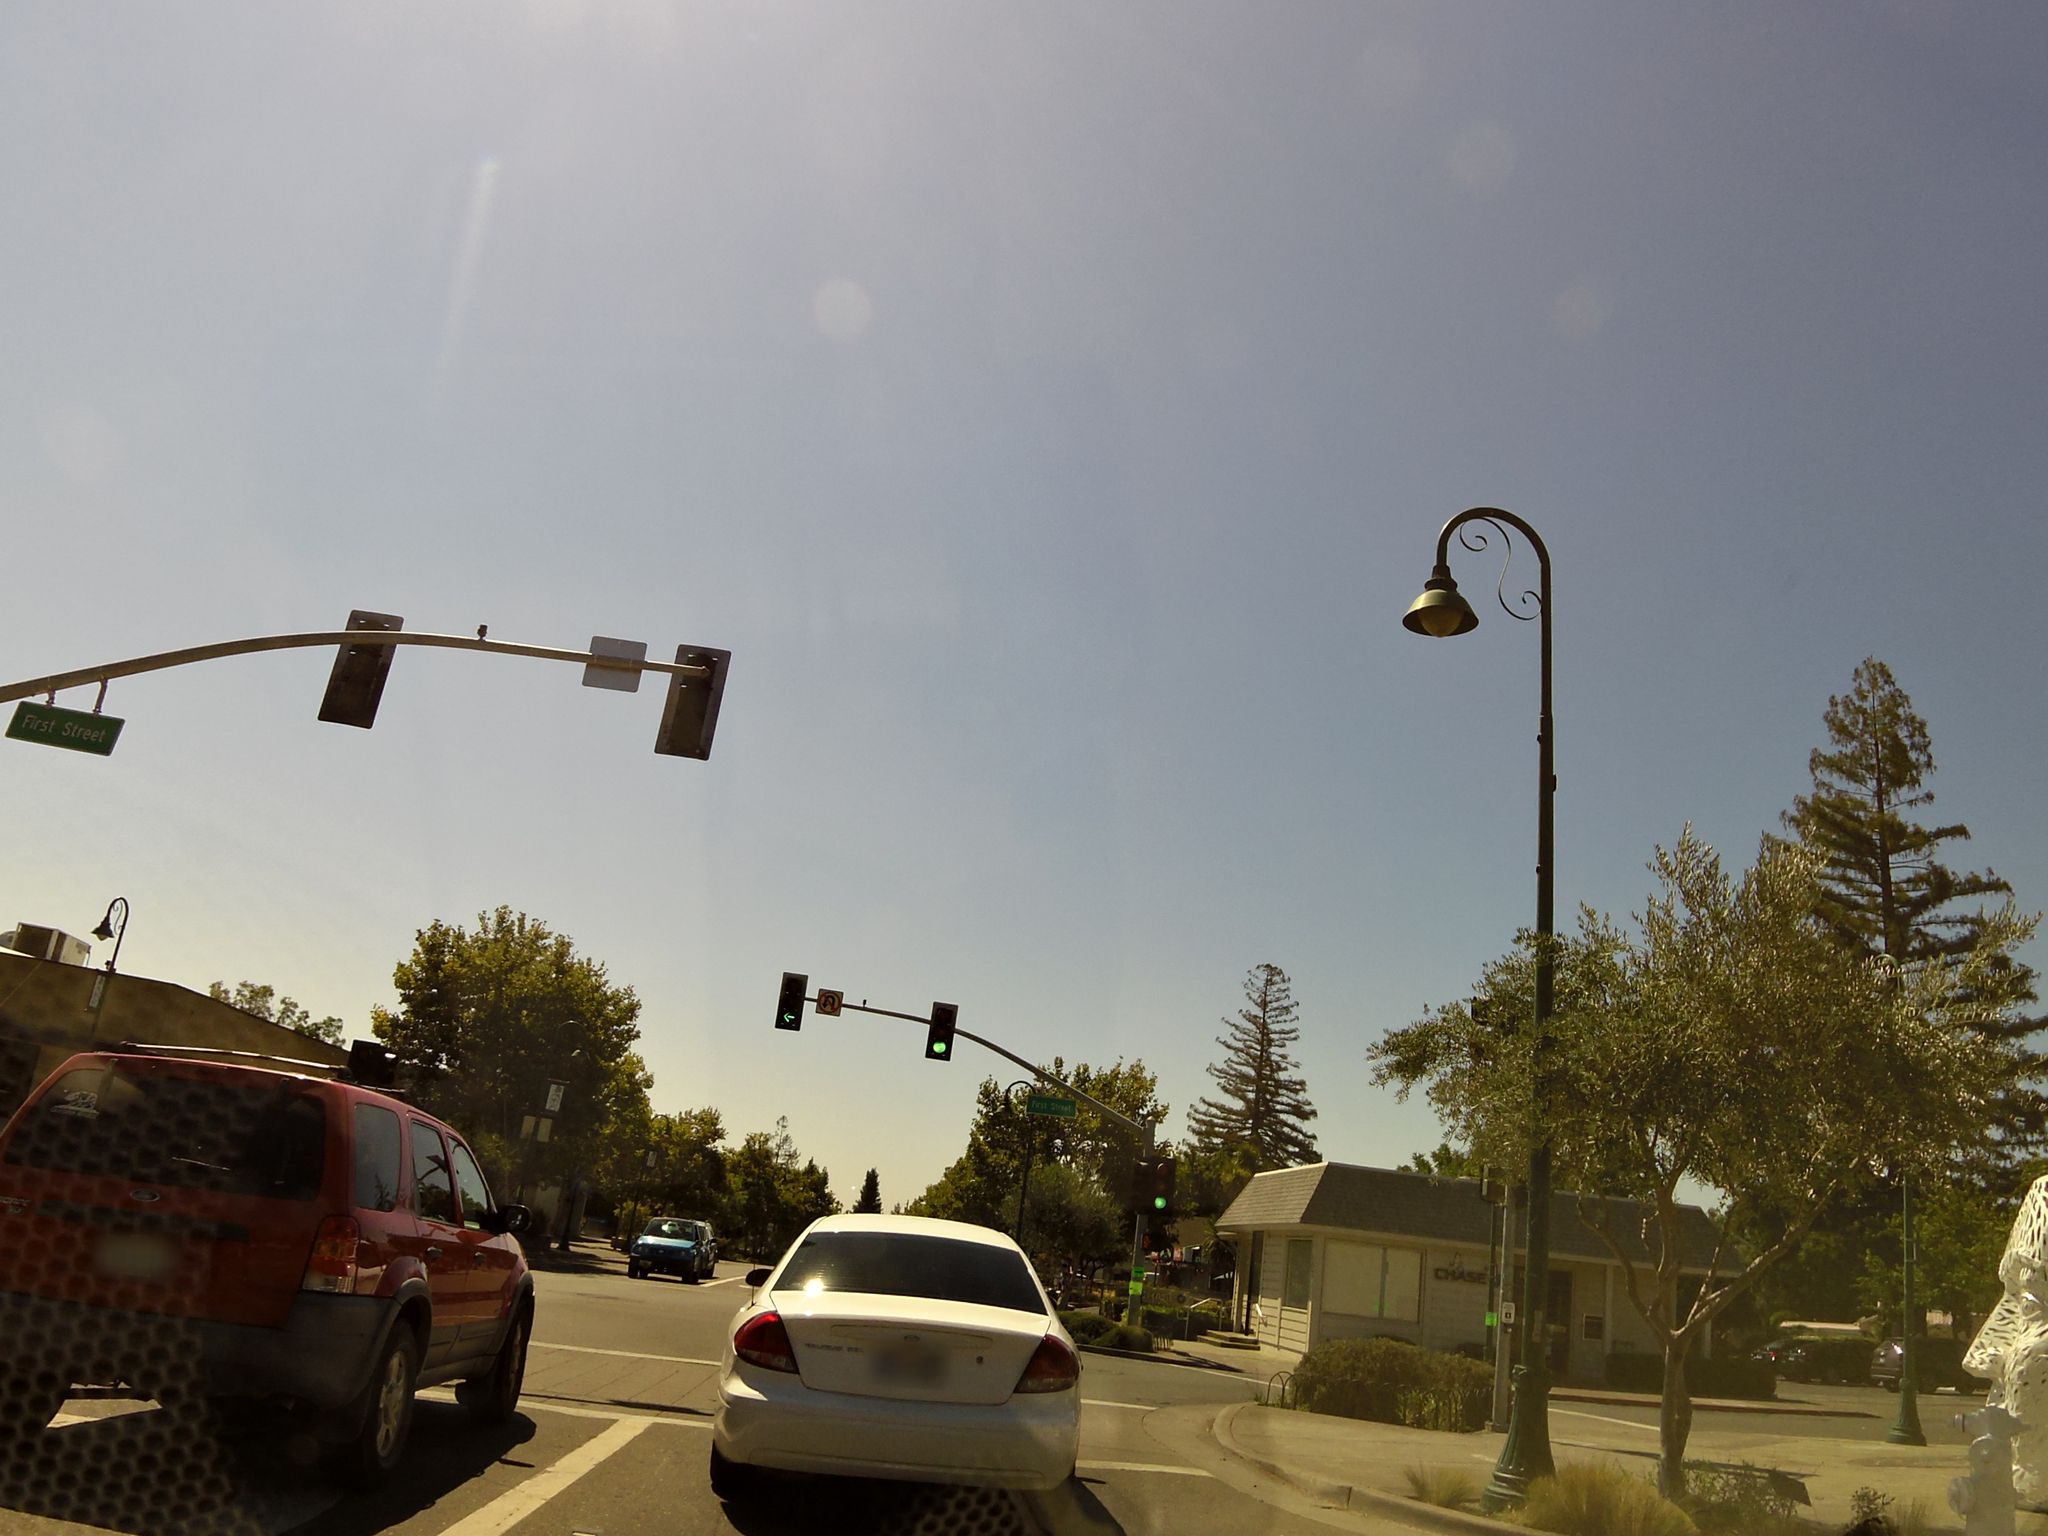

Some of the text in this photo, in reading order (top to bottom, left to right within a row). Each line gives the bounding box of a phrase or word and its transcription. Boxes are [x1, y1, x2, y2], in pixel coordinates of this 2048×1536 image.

[22, 714, 106, 743] First Street
[1434, 1268, 1488, 1285] CHASE
